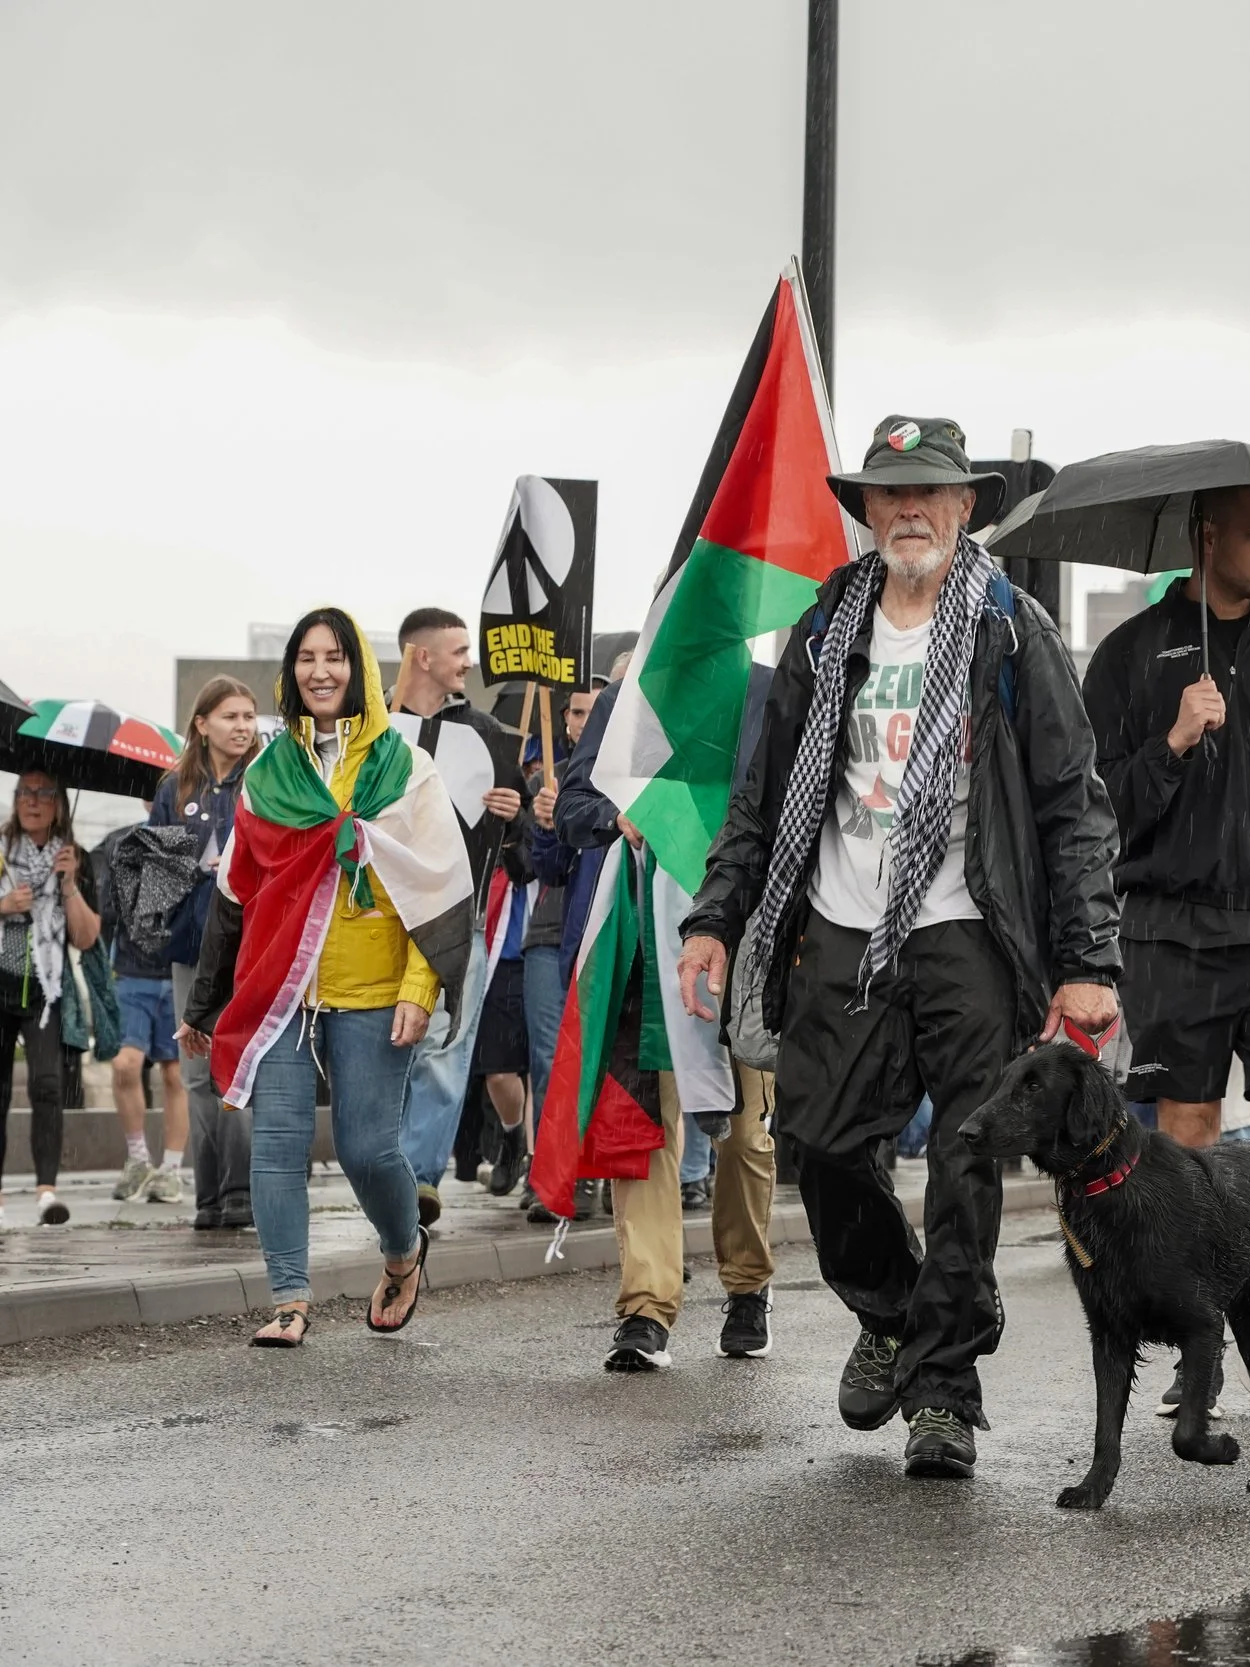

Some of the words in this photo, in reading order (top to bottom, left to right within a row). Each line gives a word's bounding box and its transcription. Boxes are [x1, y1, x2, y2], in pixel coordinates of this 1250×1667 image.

[486, 623, 531, 652] END
[531, 625, 555, 655] THE
[489, 648, 575, 683] GENOCIDE
[112, 738, 176, 764] PALESTIN
[848, 713, 880, 763] OR
